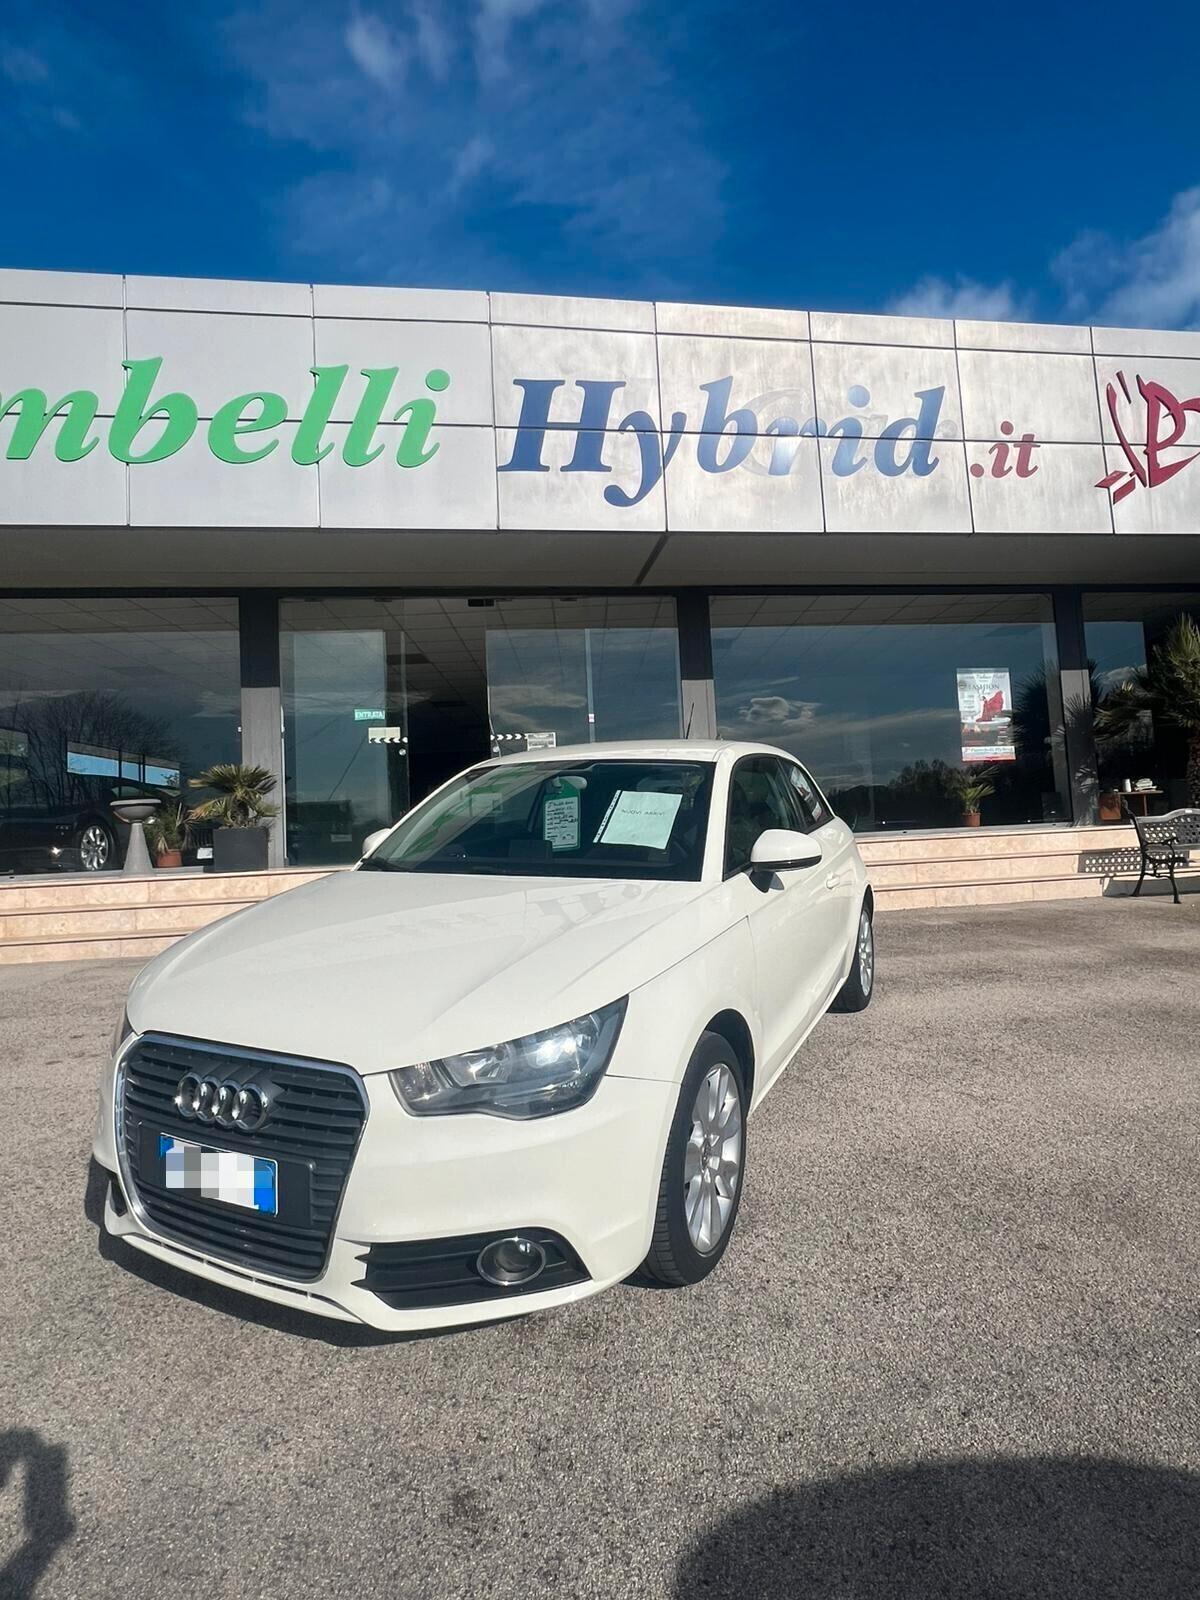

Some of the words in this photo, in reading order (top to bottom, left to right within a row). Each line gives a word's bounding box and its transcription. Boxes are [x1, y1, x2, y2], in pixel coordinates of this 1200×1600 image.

[497, 375, 945, 506] Hybrid
[968, 683, 1000, 691] FASHION
[355, 710, 385, 719] ENTRATA
